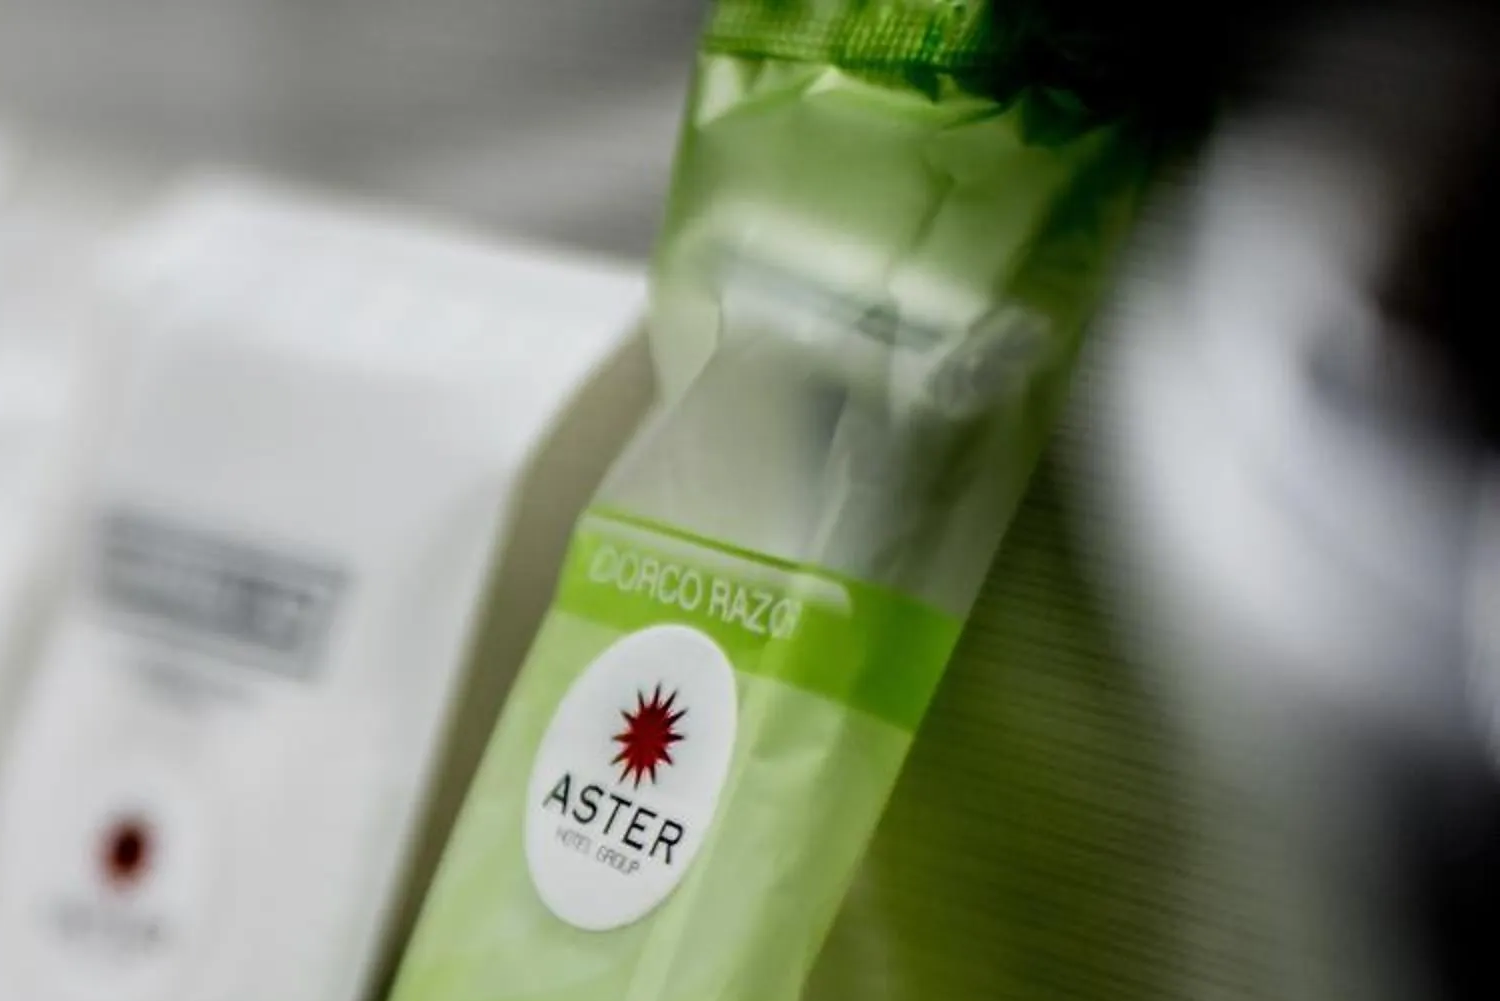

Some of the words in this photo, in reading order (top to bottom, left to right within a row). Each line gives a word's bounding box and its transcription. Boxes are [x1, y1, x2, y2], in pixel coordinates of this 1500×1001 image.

[587, 546, 702, 612] DORCO
[707, 577, 804, 640] RAZO
[541, 772, 685, 866] ASTER
[596, 845, 641, 876] GROUP
